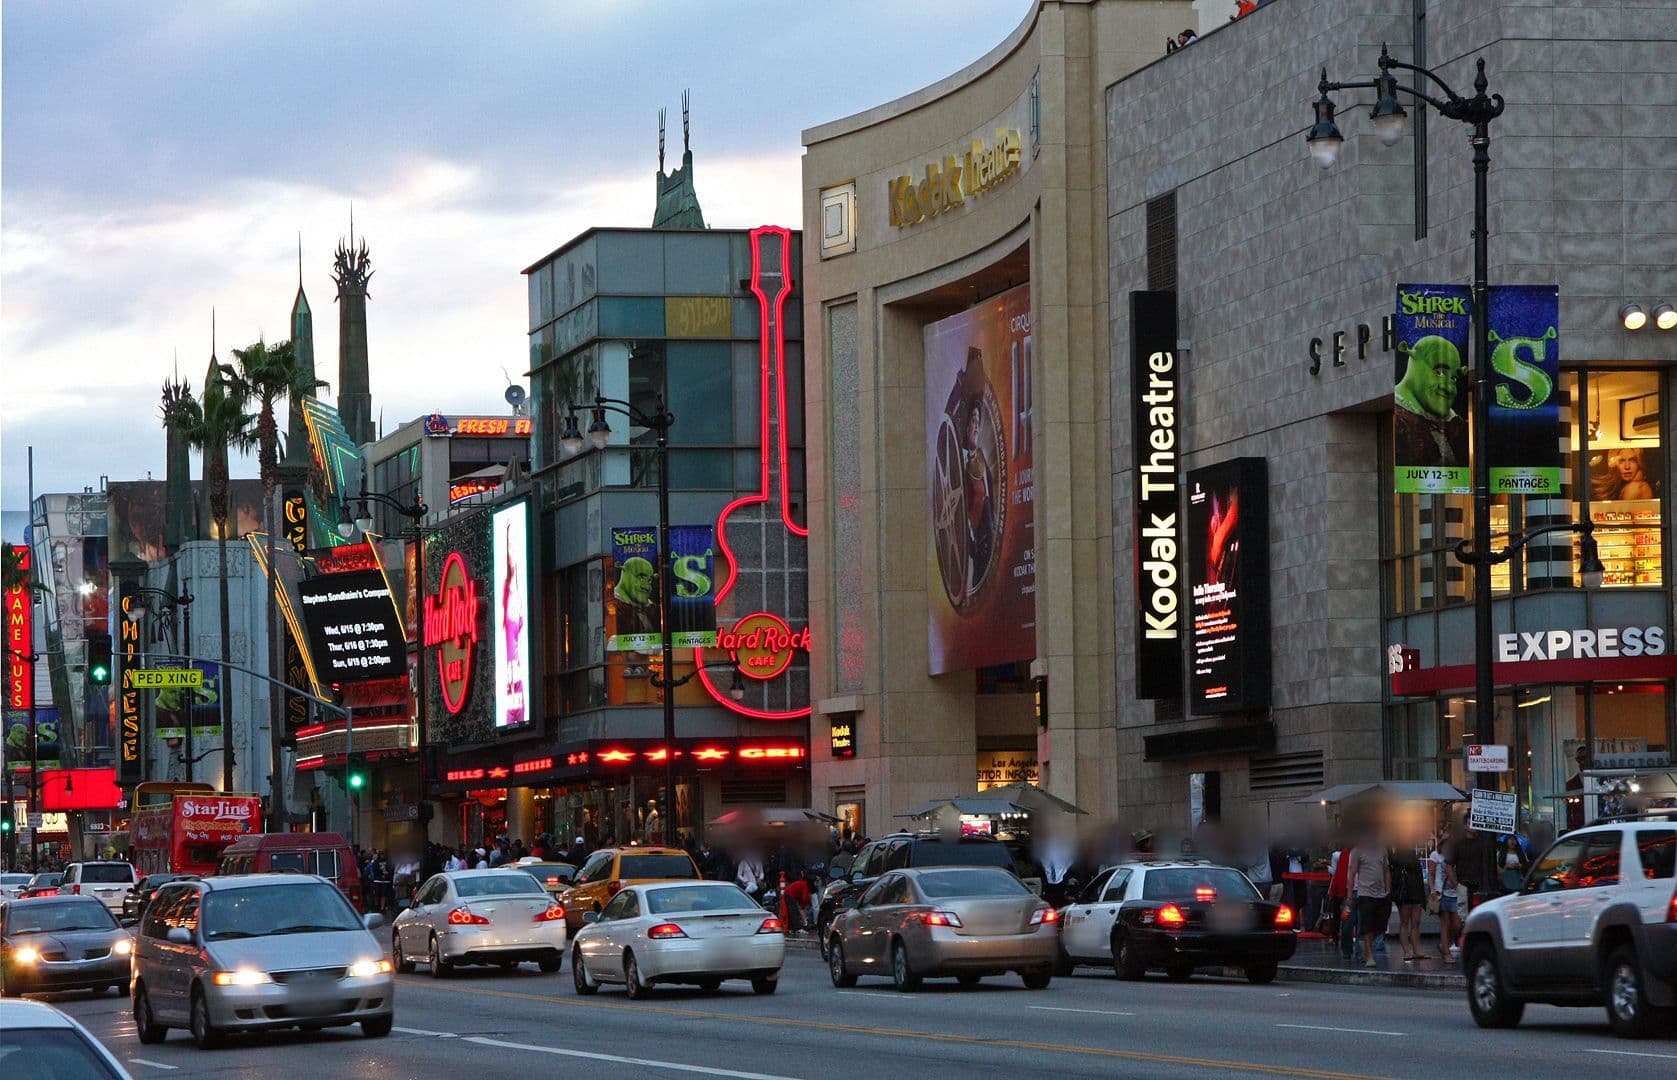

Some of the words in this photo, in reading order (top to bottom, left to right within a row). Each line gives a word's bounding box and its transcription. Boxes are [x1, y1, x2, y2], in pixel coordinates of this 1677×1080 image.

[457, 418, 509, 434] FRESH
[1140, 351, 1176, 500] Theatre
[1406, 470, 1429, 480] JULY
[1498, 478, 1550, 488] PANTAGES
[1142, 512, 1177, 639] Kodak
[424, 589, 450, 647] Hard
[450, 581, 479, 649] Rock
[764, 626, 811, 653] Rock
[1499, 626, 1666, 663] EXPRESS
[748, 656, 776, 667] CAFE
[138, 673, 163, 684] PED
[168, 673, 197, 684] XING
[447, 659, 463, 683] CAFE
[831, 725, 850, 738] Kodak
[992, 757, 1006, 768] Los
